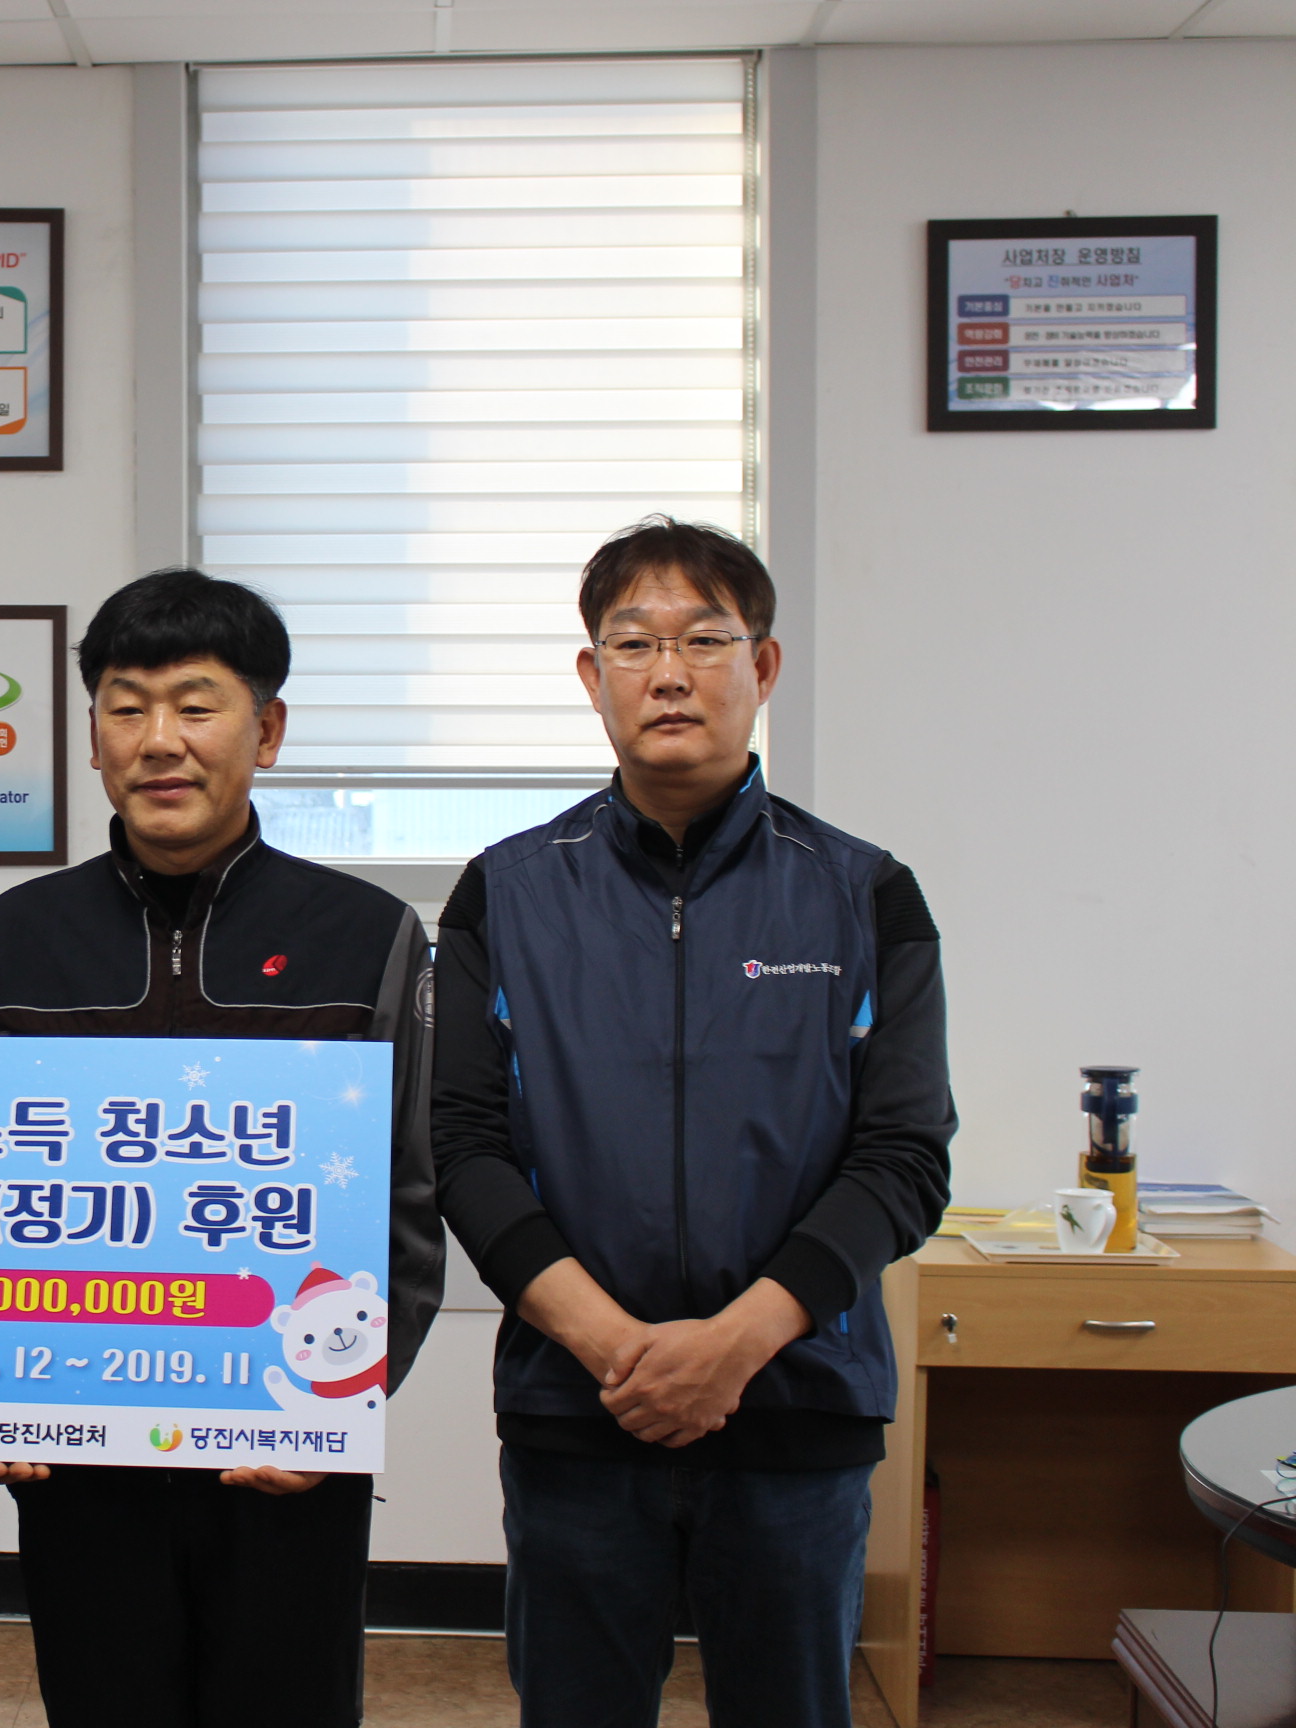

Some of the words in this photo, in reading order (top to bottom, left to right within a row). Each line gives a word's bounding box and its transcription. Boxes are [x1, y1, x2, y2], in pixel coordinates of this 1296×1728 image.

[1002, 248, 1065, 266] 사업처장
[1078, 247, 1141, 265] 운영방침
[100, 1100, 296, 1167] 청소년
[183, 1184, 317, 1250] 후원
[15, 1347, 52, 1379] 12
[102, 1349, 206, 1384] 2019.
[222, 1352, 250, 1385] 11
[190, 1427, 349, 1453] 당진시복지재단
